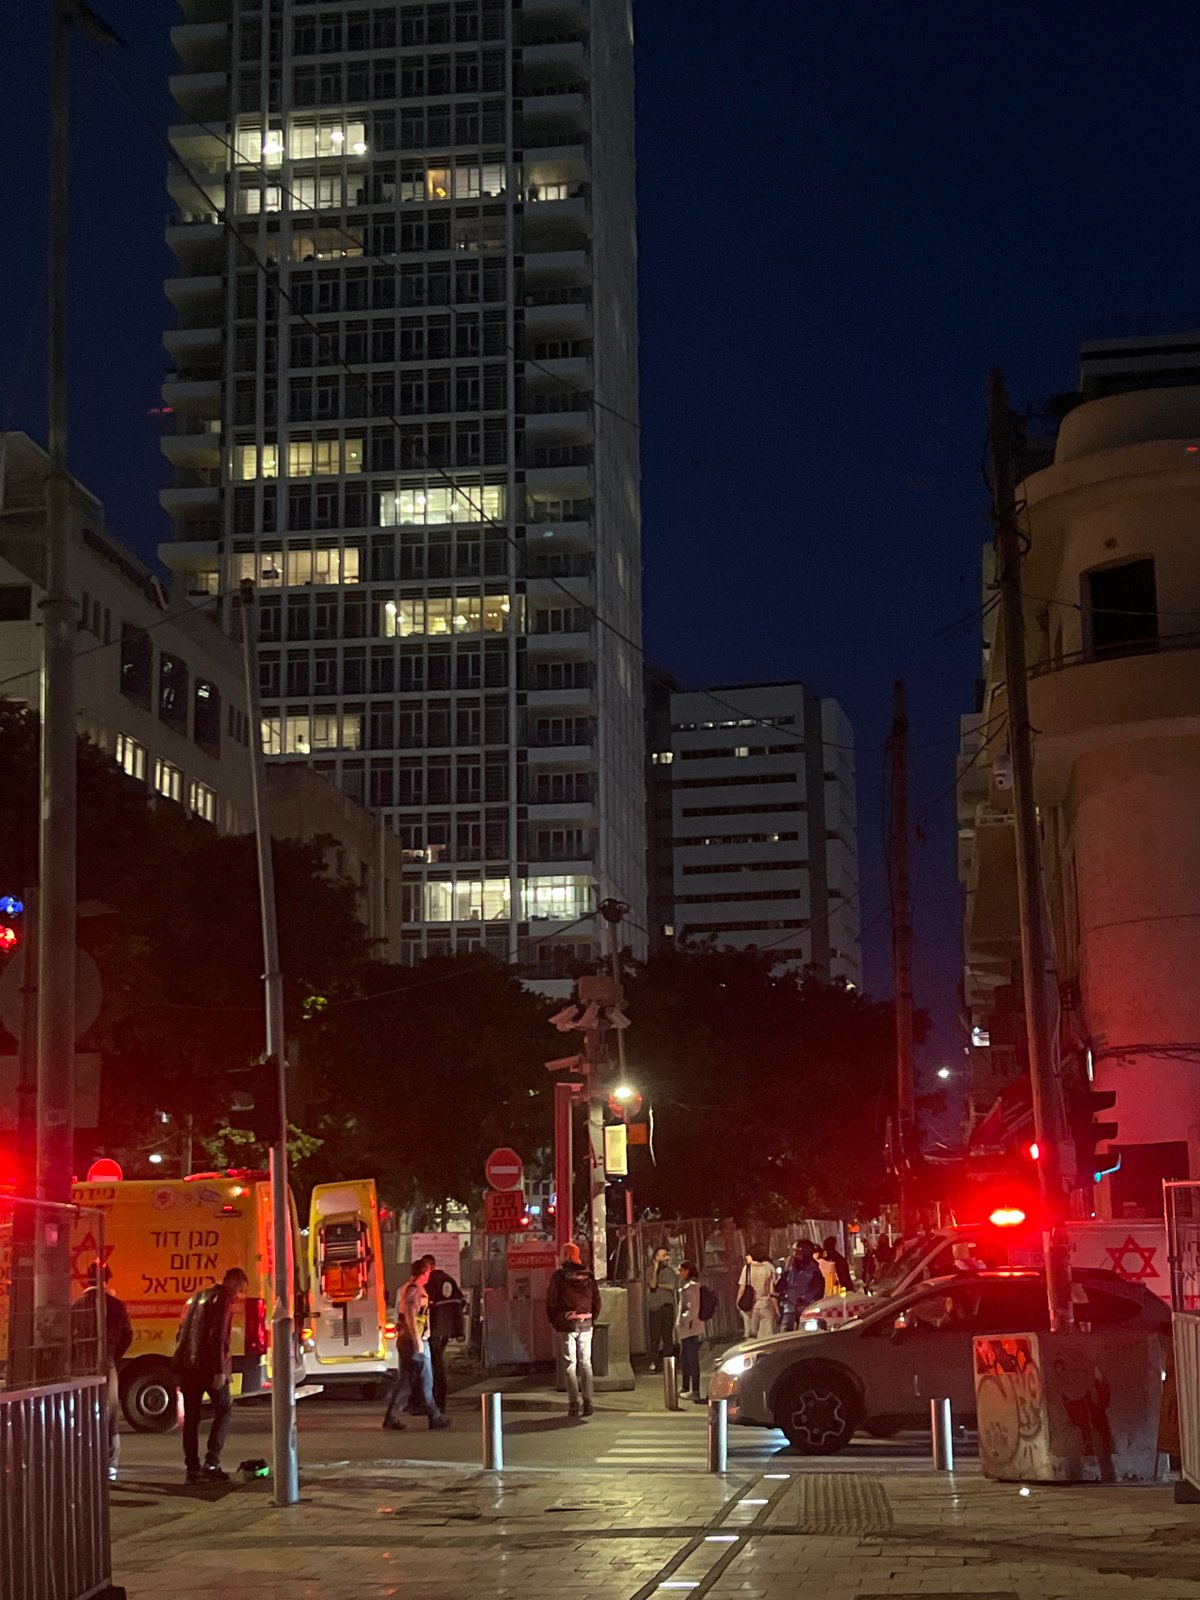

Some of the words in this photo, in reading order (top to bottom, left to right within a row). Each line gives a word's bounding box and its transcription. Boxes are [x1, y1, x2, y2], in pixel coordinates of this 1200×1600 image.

[493, 1206, 517, 1218] לרכב
[150, 1231, 181, 1248] דוד
[189, 1230, 219, 1249] מגן
[171, 1253, 218, 1270] אדום
